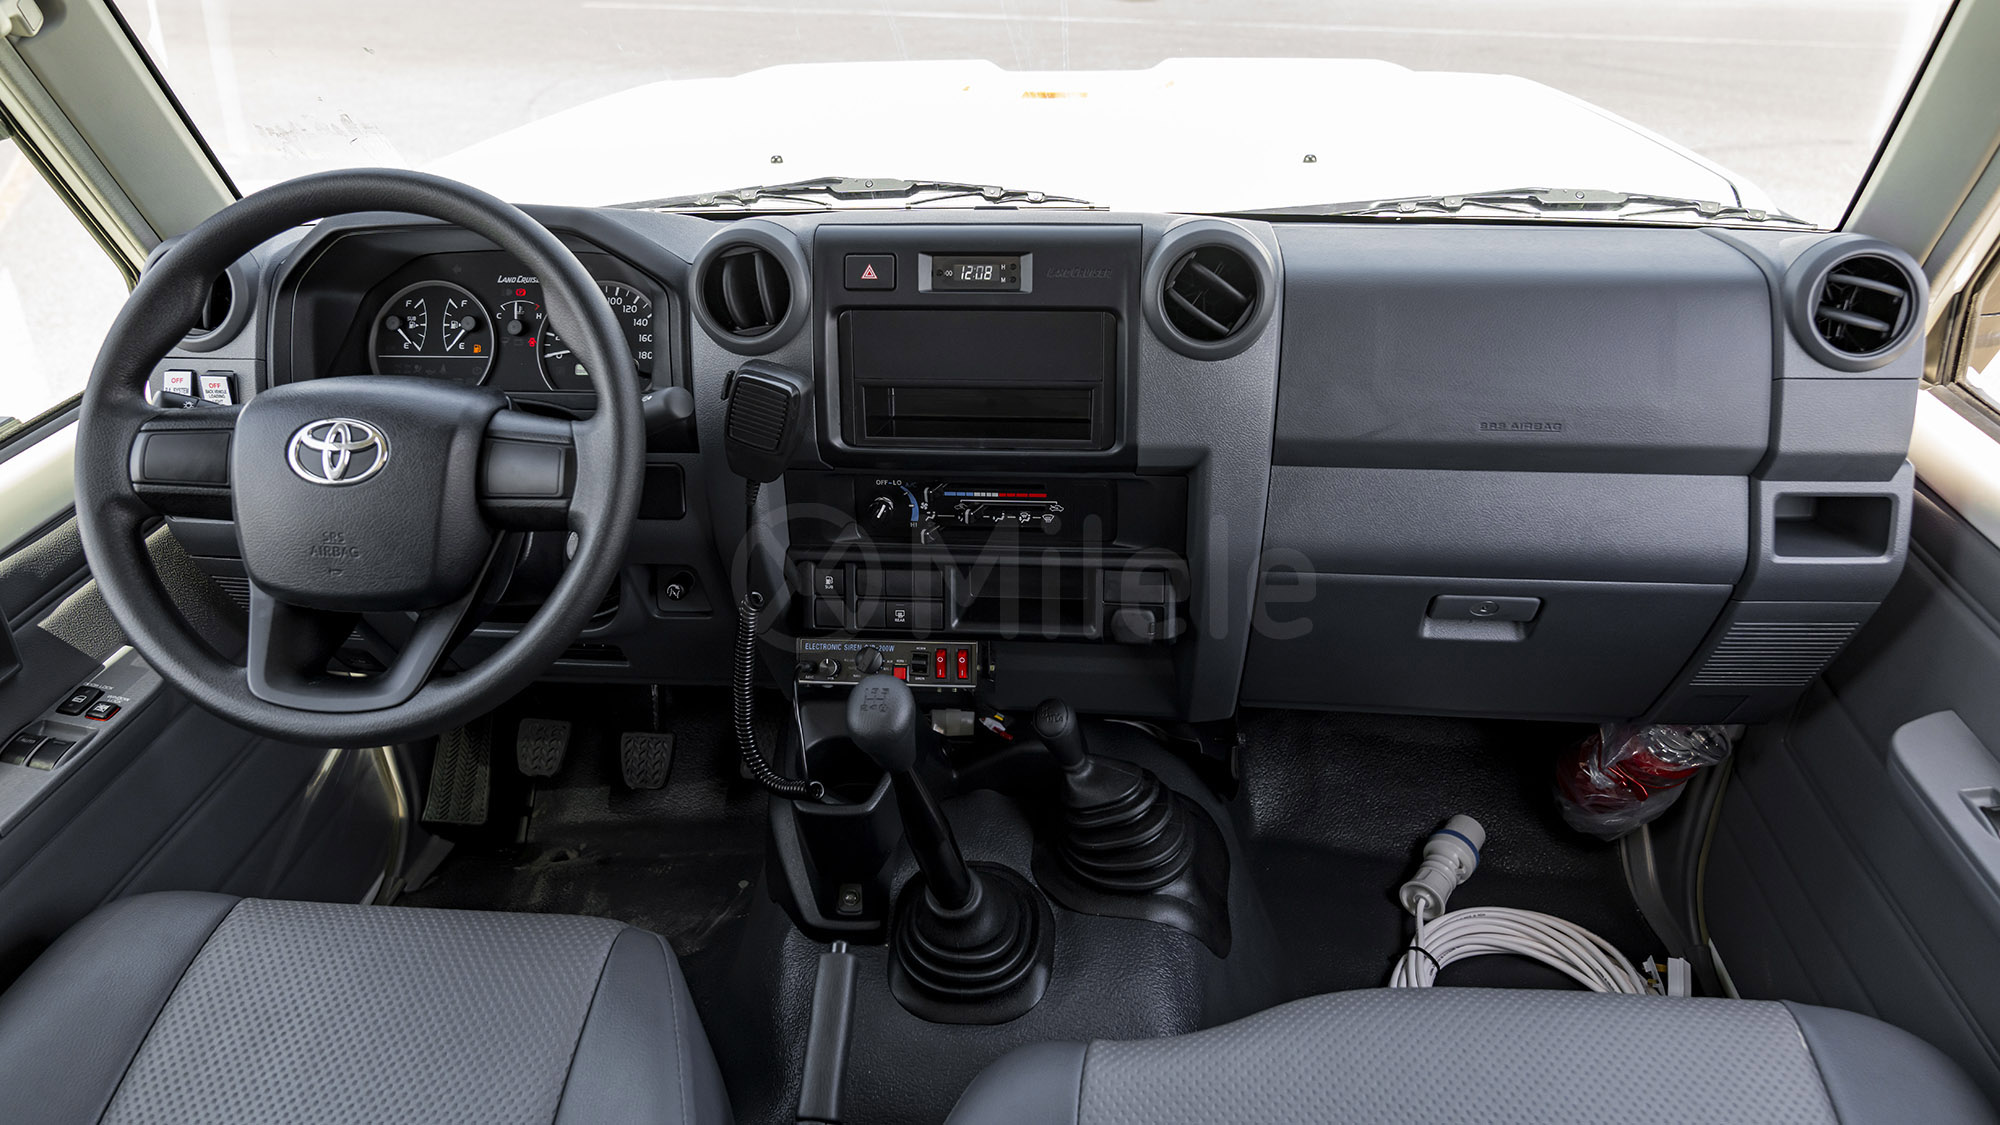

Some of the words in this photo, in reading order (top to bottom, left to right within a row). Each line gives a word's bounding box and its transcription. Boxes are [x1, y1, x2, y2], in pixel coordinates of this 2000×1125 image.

[959, 265, 993, 281] 12:08
[497, 275, 517, 284] LAND
[516, 275, 540, 284] CRUIS
[622, 305, 638, 313] 120
[496, 312, 502, 320] C
[535, 312, 542, 320] H
[633, 318, 649, 327] 140
[403, 342, 409, 350] E
[459, 342, 465, 350] E
[1511, 422, 1562, 431] AIRBAG
[322, 530, 346, 544] SRS
[309, 545, 361, 559] AIRBAG
[804, 642, 842, 651] ELECTRONIC
[843, 643, 862, 651] SIREN
